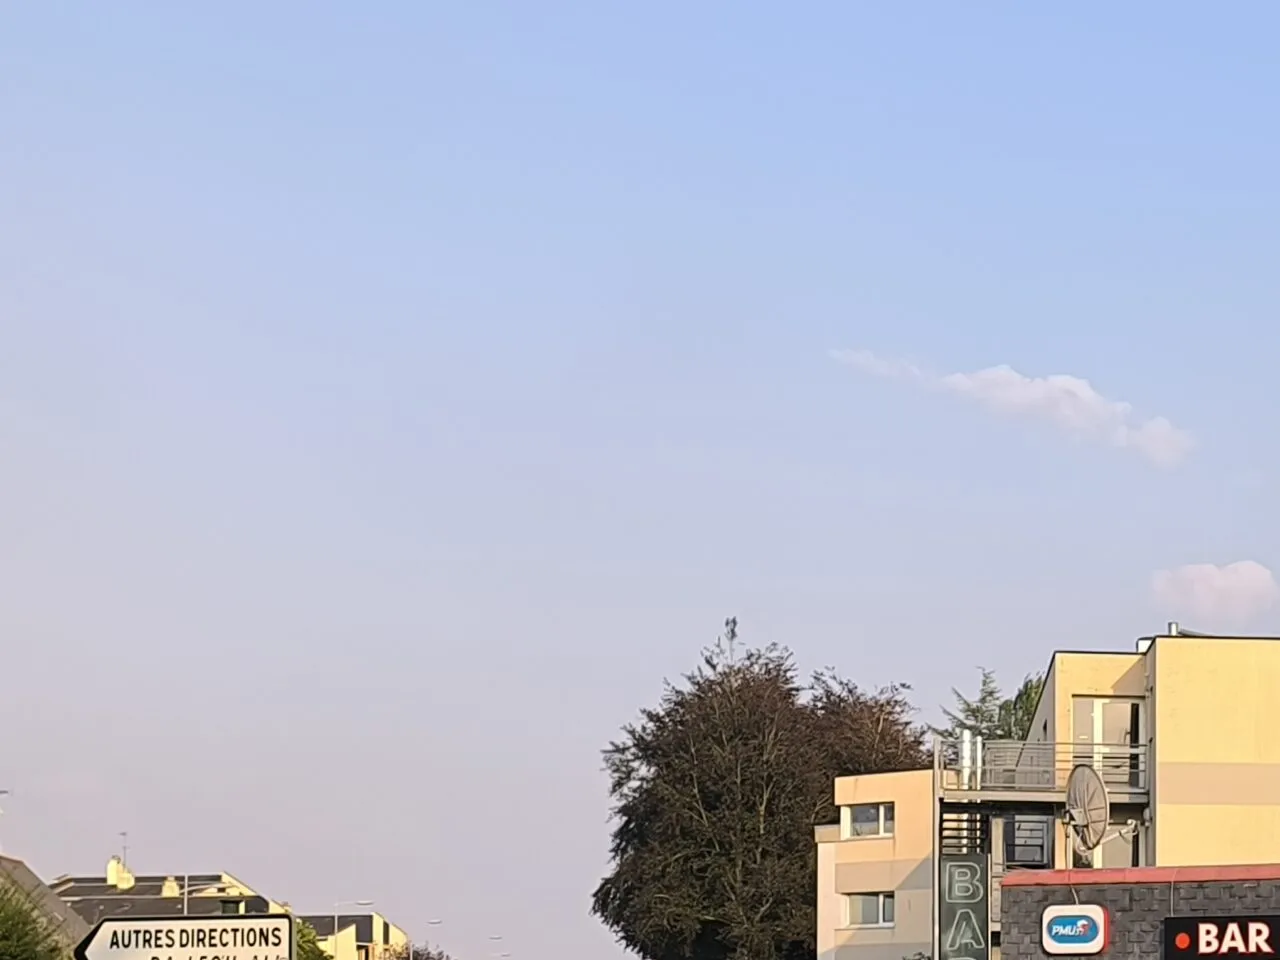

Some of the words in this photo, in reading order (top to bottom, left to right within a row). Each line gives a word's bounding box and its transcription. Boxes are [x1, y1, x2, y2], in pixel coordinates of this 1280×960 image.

[109, 928, 175, 949] AUTRES
[179, 927, 282, 948] DIRECTIONS
[1051, 924, 1077, 936] PMU
[1197, 921, 1274, 955] BAR
